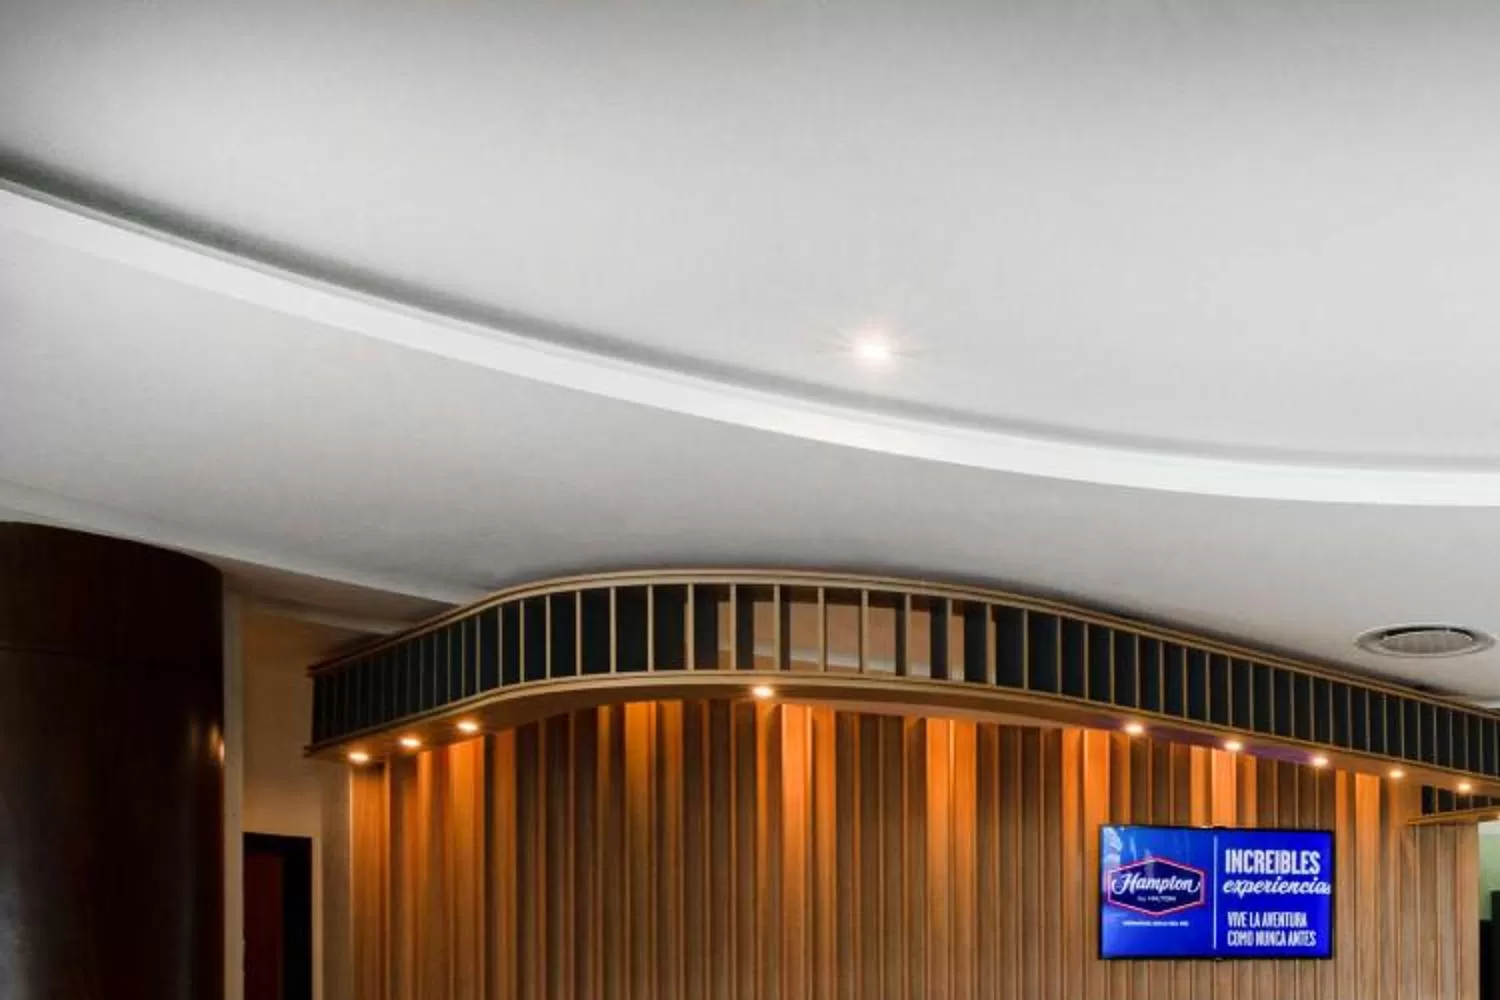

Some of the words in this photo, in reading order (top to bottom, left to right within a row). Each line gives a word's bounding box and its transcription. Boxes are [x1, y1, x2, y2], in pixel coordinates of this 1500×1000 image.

[1225, 848, 1321, 875] INCREIBLES
[1111, 872, 1201, 896] Hampton
[1227, 911, 1247, 928] VIVE
[1249, 911, 1260, 928] LA
[1262, 911, 1308, 928] AVENTURA
[1227, 930, 1254, 947] COMO
[1255, 930, 1287, 947] NUNCA
[1288, 930, 1317, 947] ANTES
